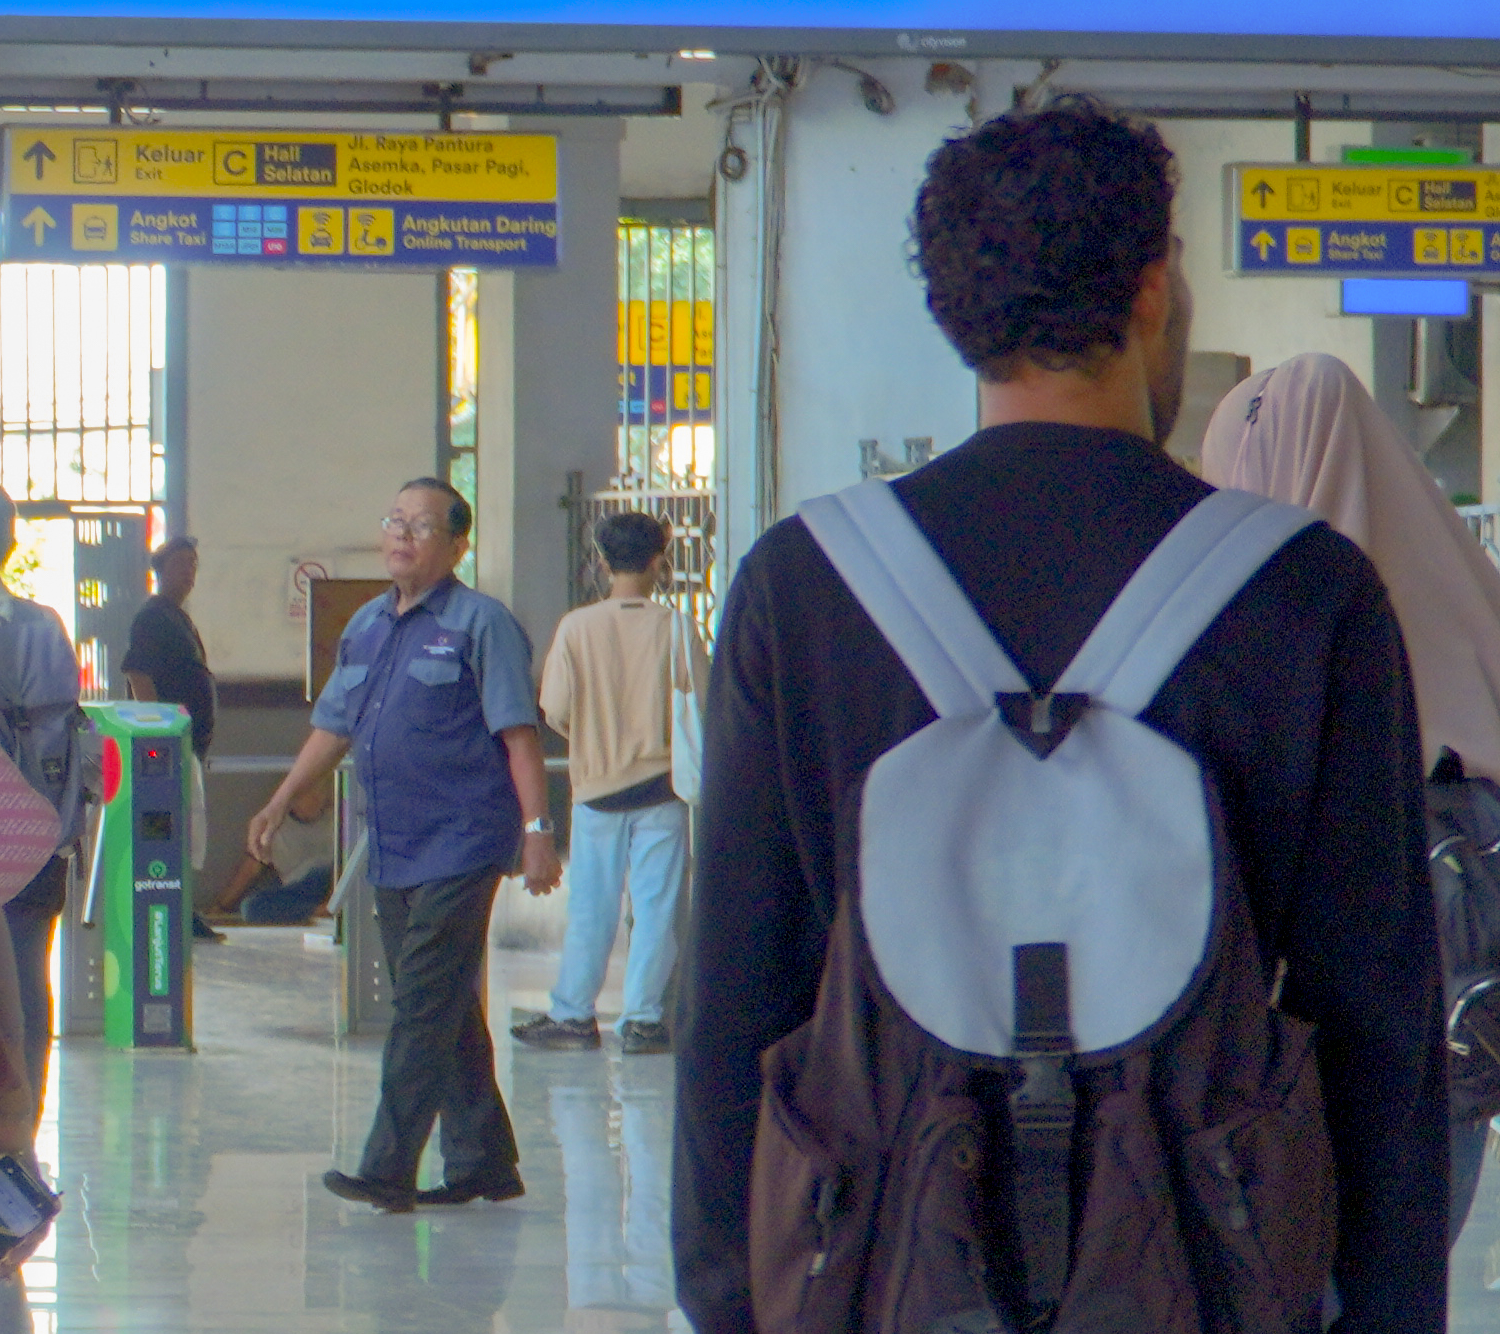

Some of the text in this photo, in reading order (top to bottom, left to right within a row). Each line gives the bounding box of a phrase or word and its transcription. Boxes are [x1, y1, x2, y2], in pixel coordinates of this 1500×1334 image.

[135, 145, 205, 163] Keluar
[263, 146, 300, 163] Hall
[376, 137, 418, 155] Raya
[424, 137, 494, 153] Pantura
[223, 150, 247, 175] C
[349, 158, 530, 178] Asemka, Pasar Pagi,
[135, 168, 162, 180] Exit
[263, 166, 333, 183] Selatan
[349, 179, 413, 194] Glodok
[1395, 186, 1413, 205] C
[130, 210, 197, 231] Angkot
[403, 214, 558, 237] Angkutan Daring
[403, 236, 526, 253] Online Transport
